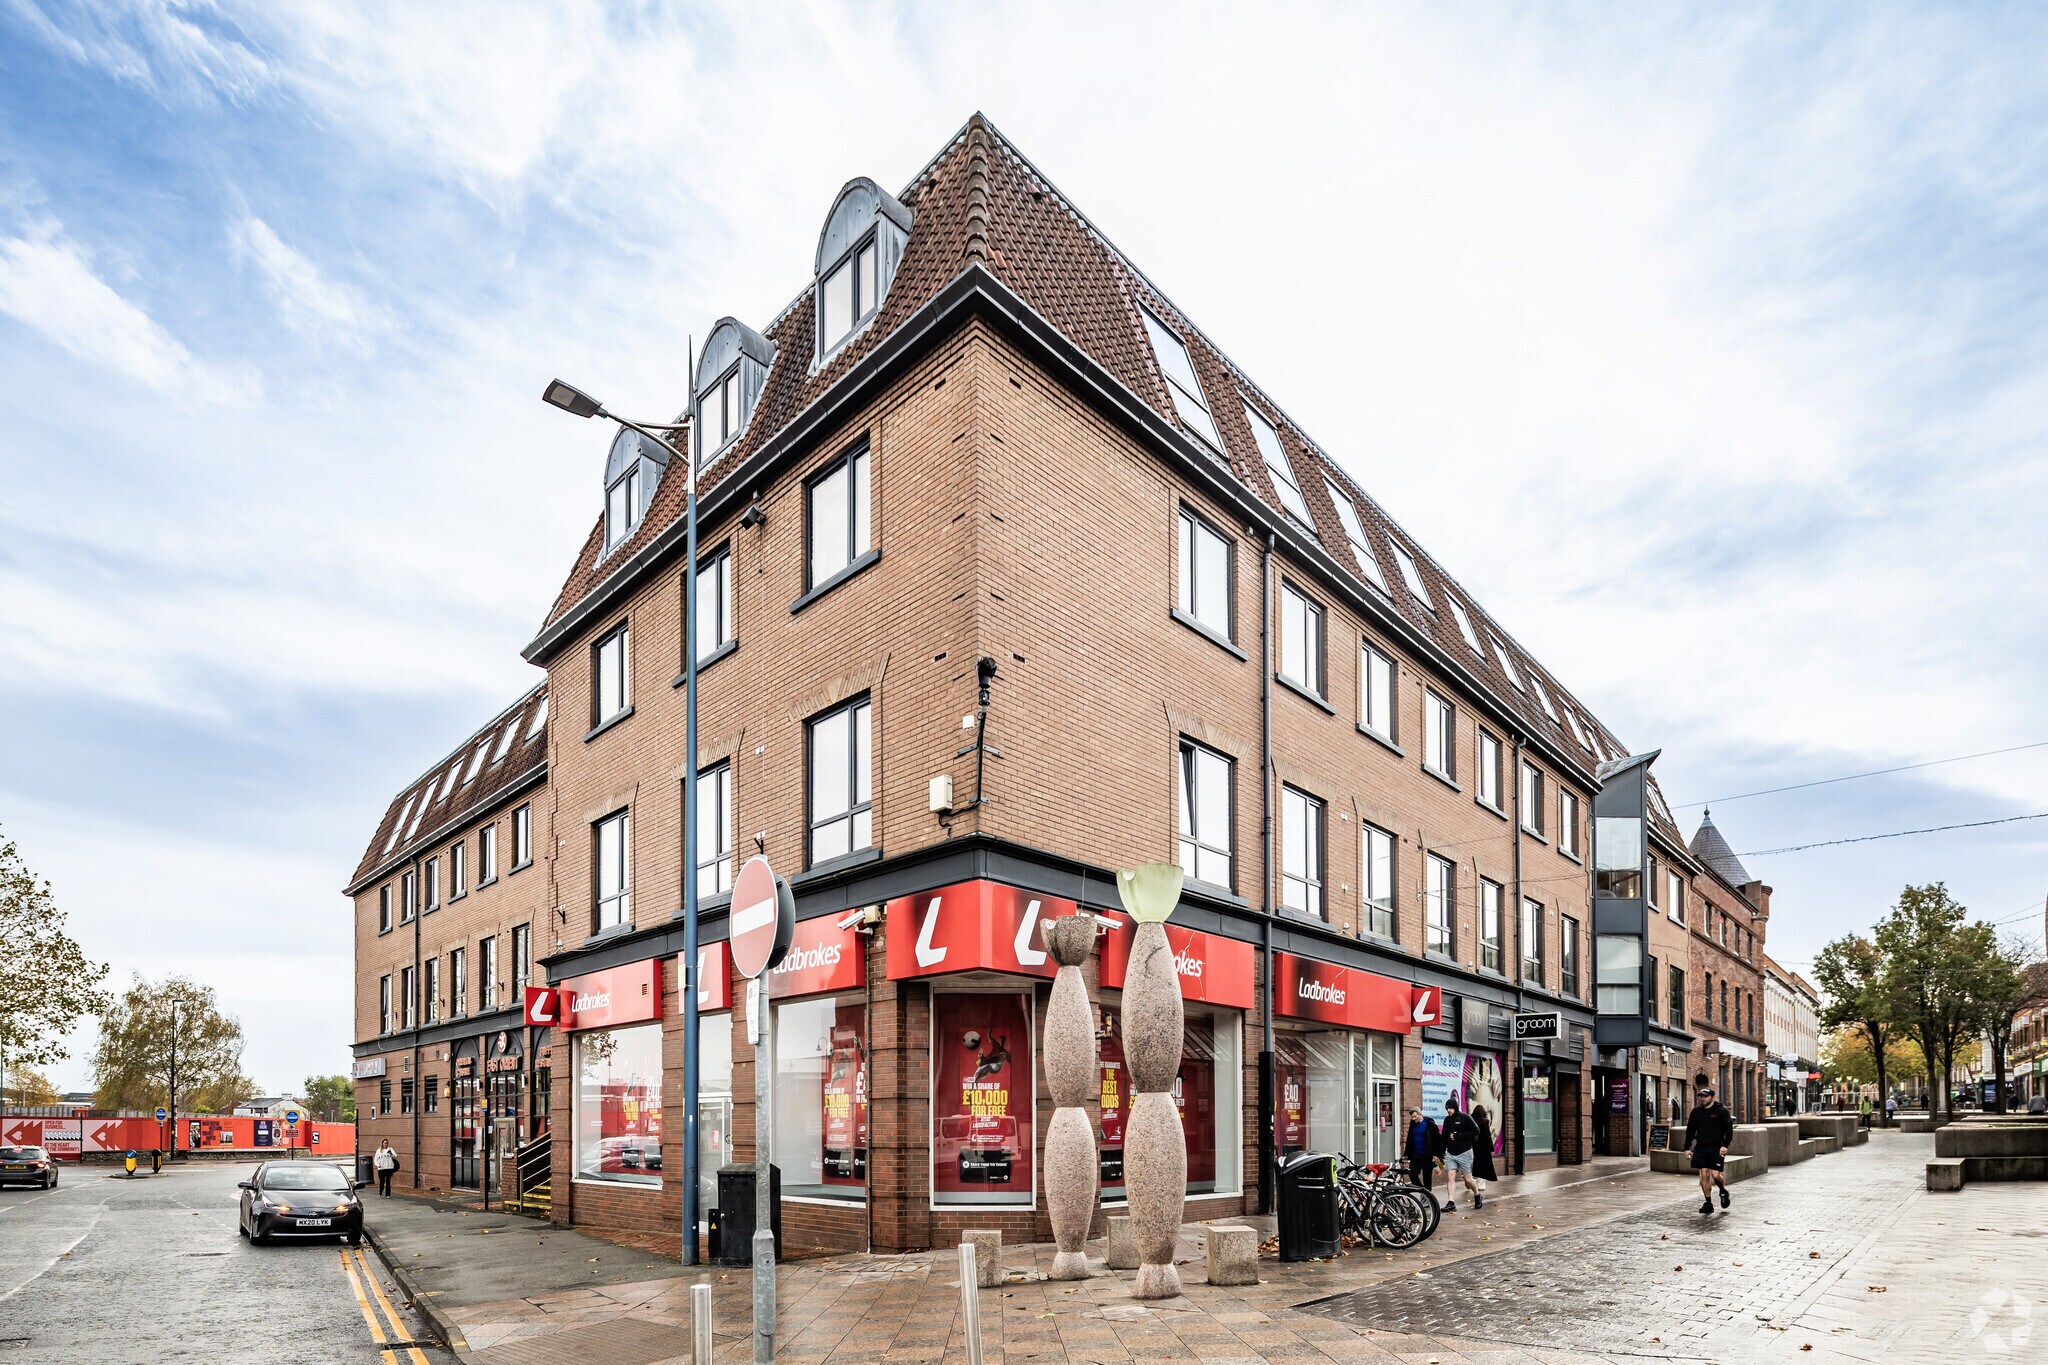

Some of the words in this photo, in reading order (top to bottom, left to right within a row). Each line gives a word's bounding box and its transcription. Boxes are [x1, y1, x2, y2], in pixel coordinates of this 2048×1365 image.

[914, 896, 948, 968] L
[1014, 899, 1048, 966] L
[1298, 977, 1346, 1006] Ladbrokes
[530, 992, 554, 1022] L
[571, 991, 610, 1013] Ladbrokes
[1412, 990, 1436, 1022] L
[1516, 1018, 1556, 1035] groom
[1436, 1053, 1448, 1066] The
[1448, 1054, 1462, 1072] Baby
[1106, 1069, 1114, 1080] THE
[1102, 1080, 1117, 1094] BEST
[1284, 1084, 1298, 1102] £40
[962, 1090, 1008, 1105] £10,000
[1101, 1094, 1119, 1108] ODDS
[971, 1106, 986, 1116] FOR
[988, 1106, 1006, 1116] FREE
